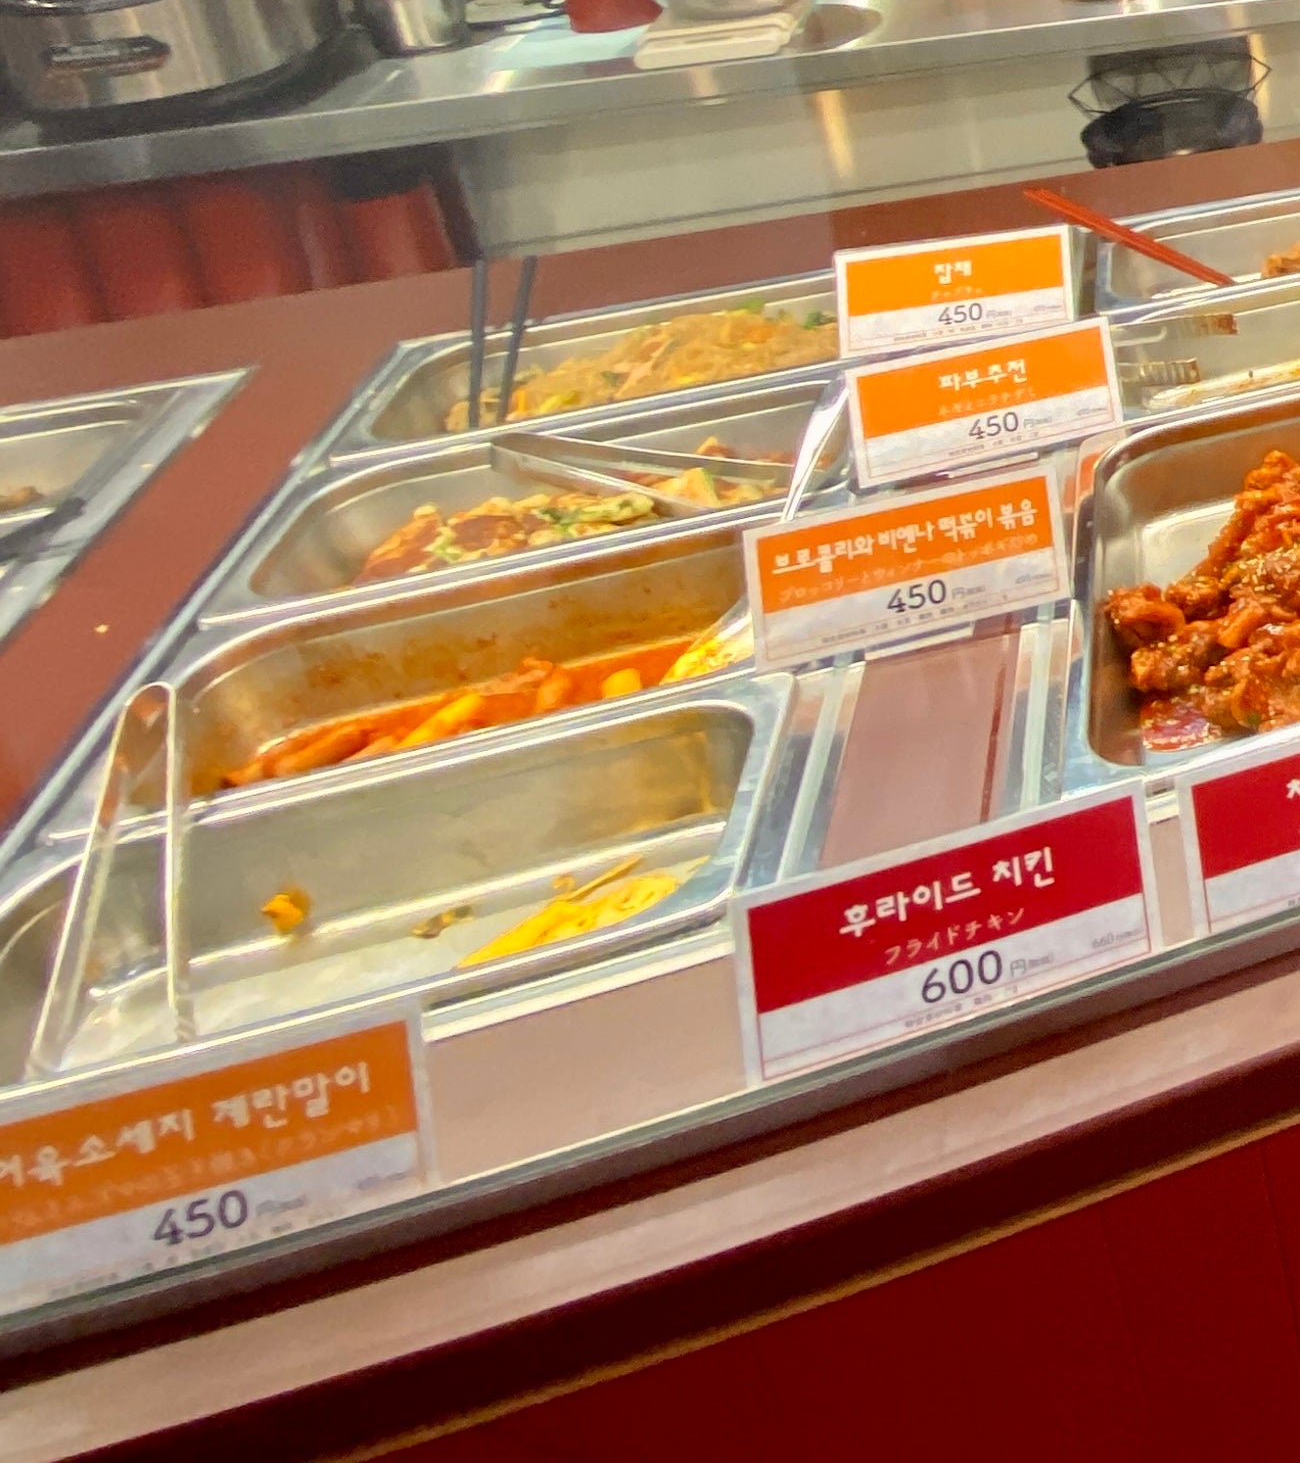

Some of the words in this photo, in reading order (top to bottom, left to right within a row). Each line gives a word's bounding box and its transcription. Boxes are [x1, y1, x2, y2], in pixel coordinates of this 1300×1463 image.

[934, 259, 972, 285] 잡채
[938, 302, 983, 326] 450
[938, 358, 1028, 392] 파부추전
[968, 411, 1019, 440] 450
[771, 534, 875, 575] 브로콜리와
[877, 520, 936, 554] 비엔나
[937, 508, 994, 543] 떡볶이
[997, 498, 1039, 531] 볶음
[885, 579, 947, 614] 450
[839, 872, 982, 938] 후라이드
[992, 846, 1056, 889] 치킨
[884, 907, 1025, 966] フライドチキン
[921, 949, 1002, 1004] 600
[211, 1060, 371, 1130] 계란말이
[152, 1188, 249, 1247] 450
